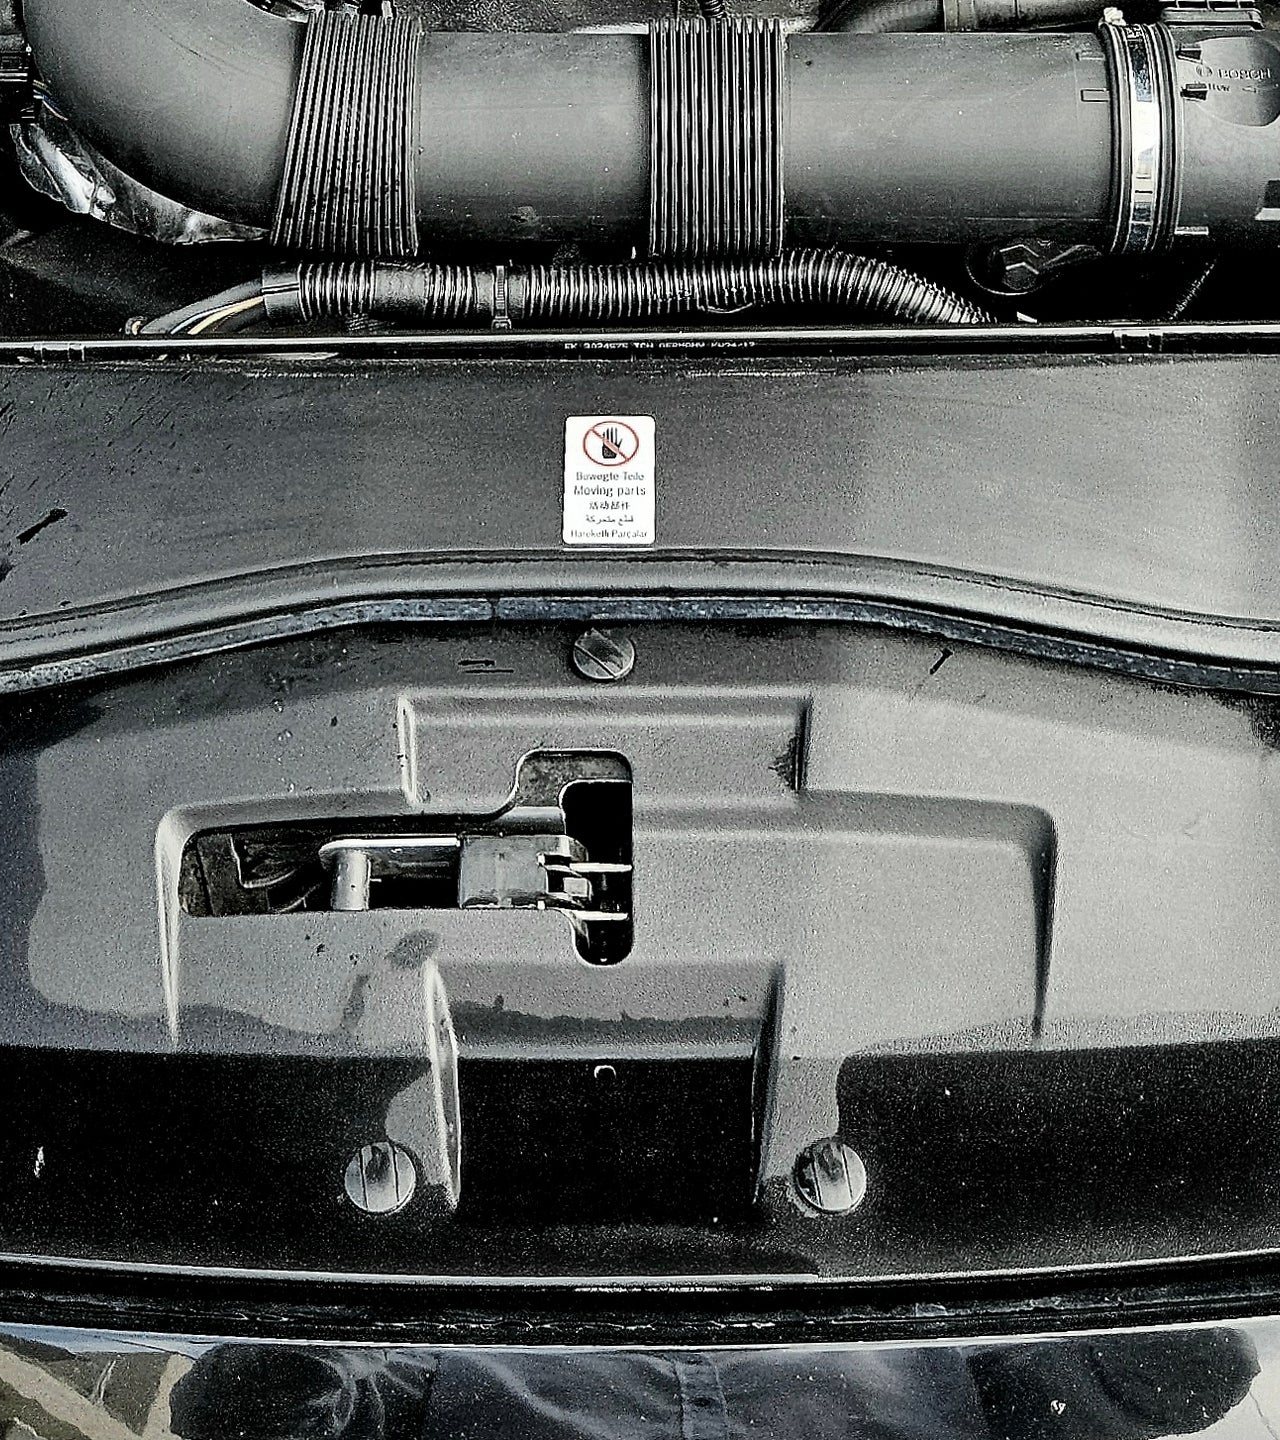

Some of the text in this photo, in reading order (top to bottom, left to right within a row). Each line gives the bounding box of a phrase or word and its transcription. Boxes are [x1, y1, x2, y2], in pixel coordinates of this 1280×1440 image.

[1217, 67, 1271, 80] BOSCH
[576, 471, 645, 482] Bewegte Teile
[573, 485, 646, 497] Moving parts
